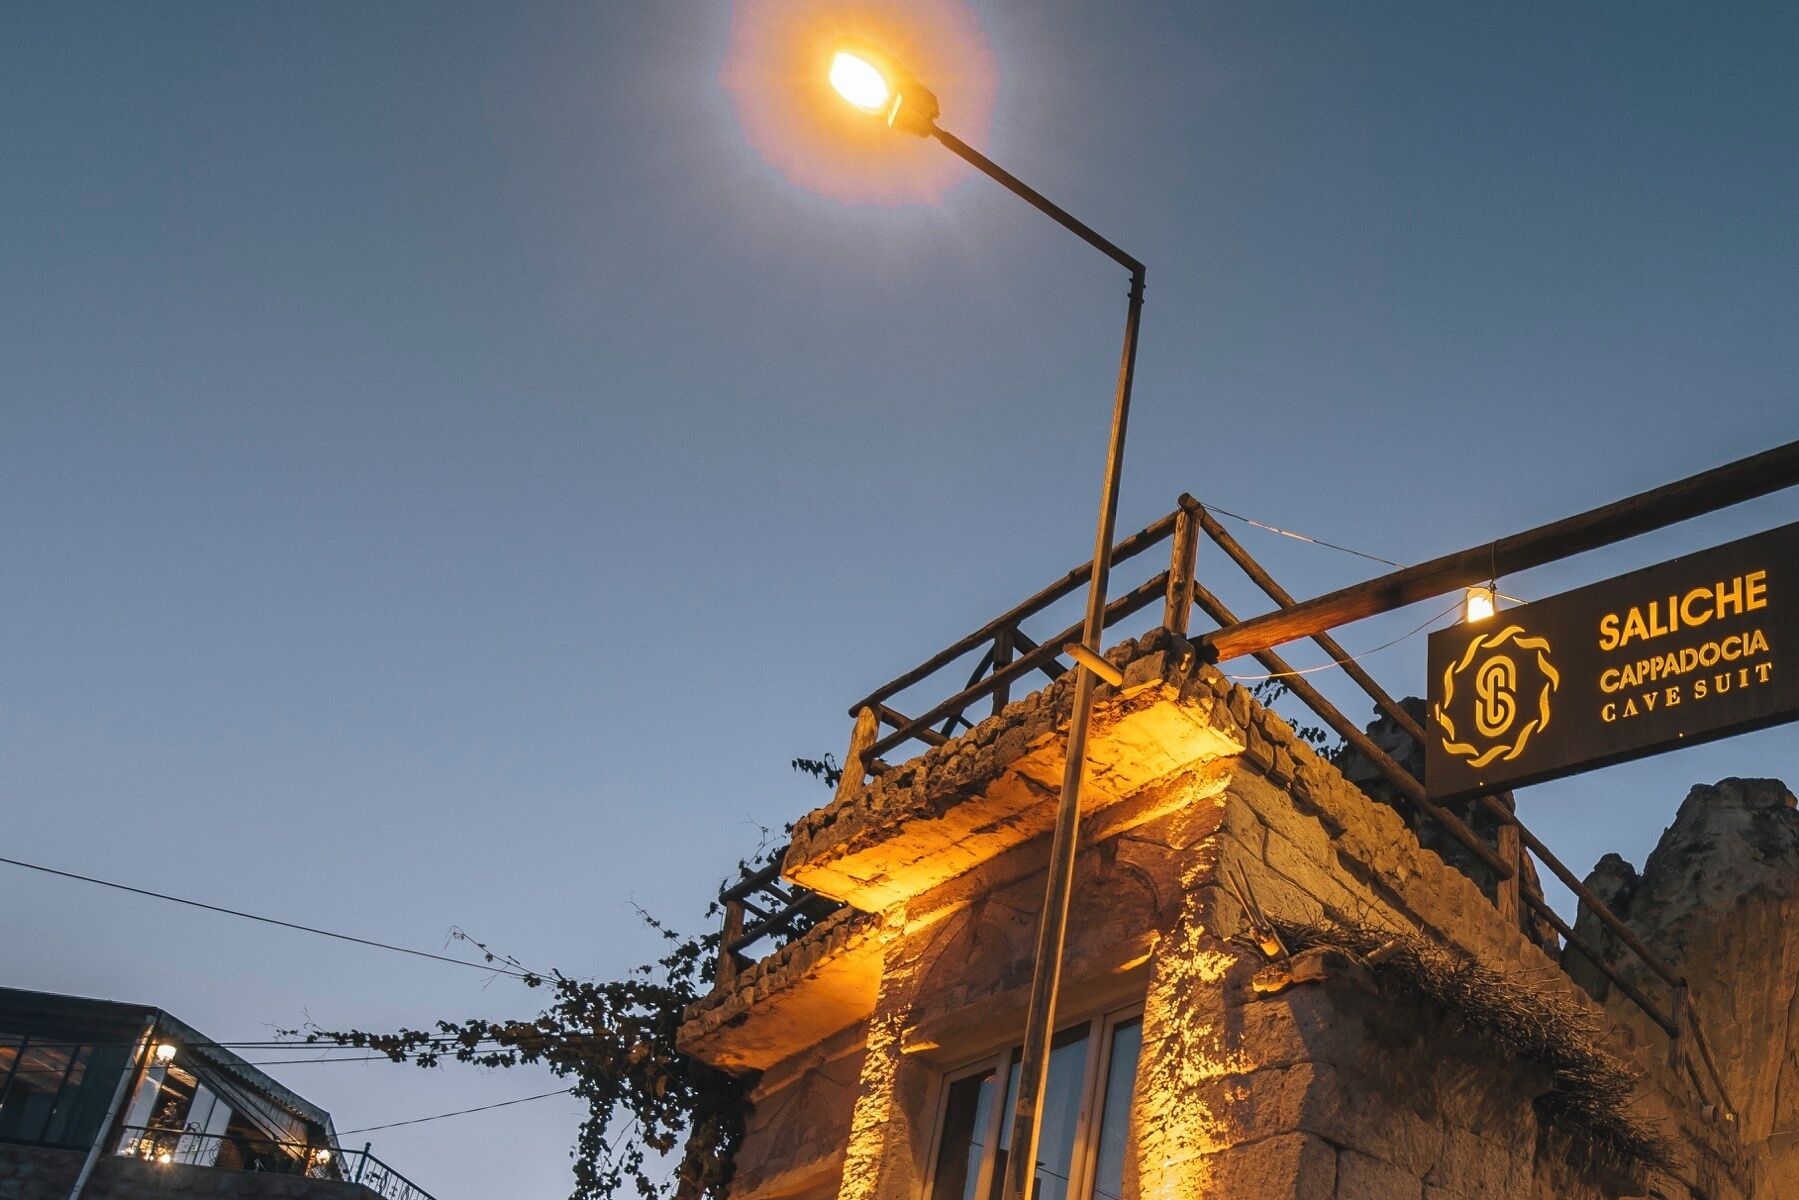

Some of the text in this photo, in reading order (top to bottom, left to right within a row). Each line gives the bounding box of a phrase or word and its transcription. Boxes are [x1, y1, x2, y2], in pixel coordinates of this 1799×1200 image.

[1599, 570, 1768, 651] SALICHE
[1600, 629, 1769, 694] CAPPADOCIA
[1602, 662, 1772, 722] CAVE SUIT
